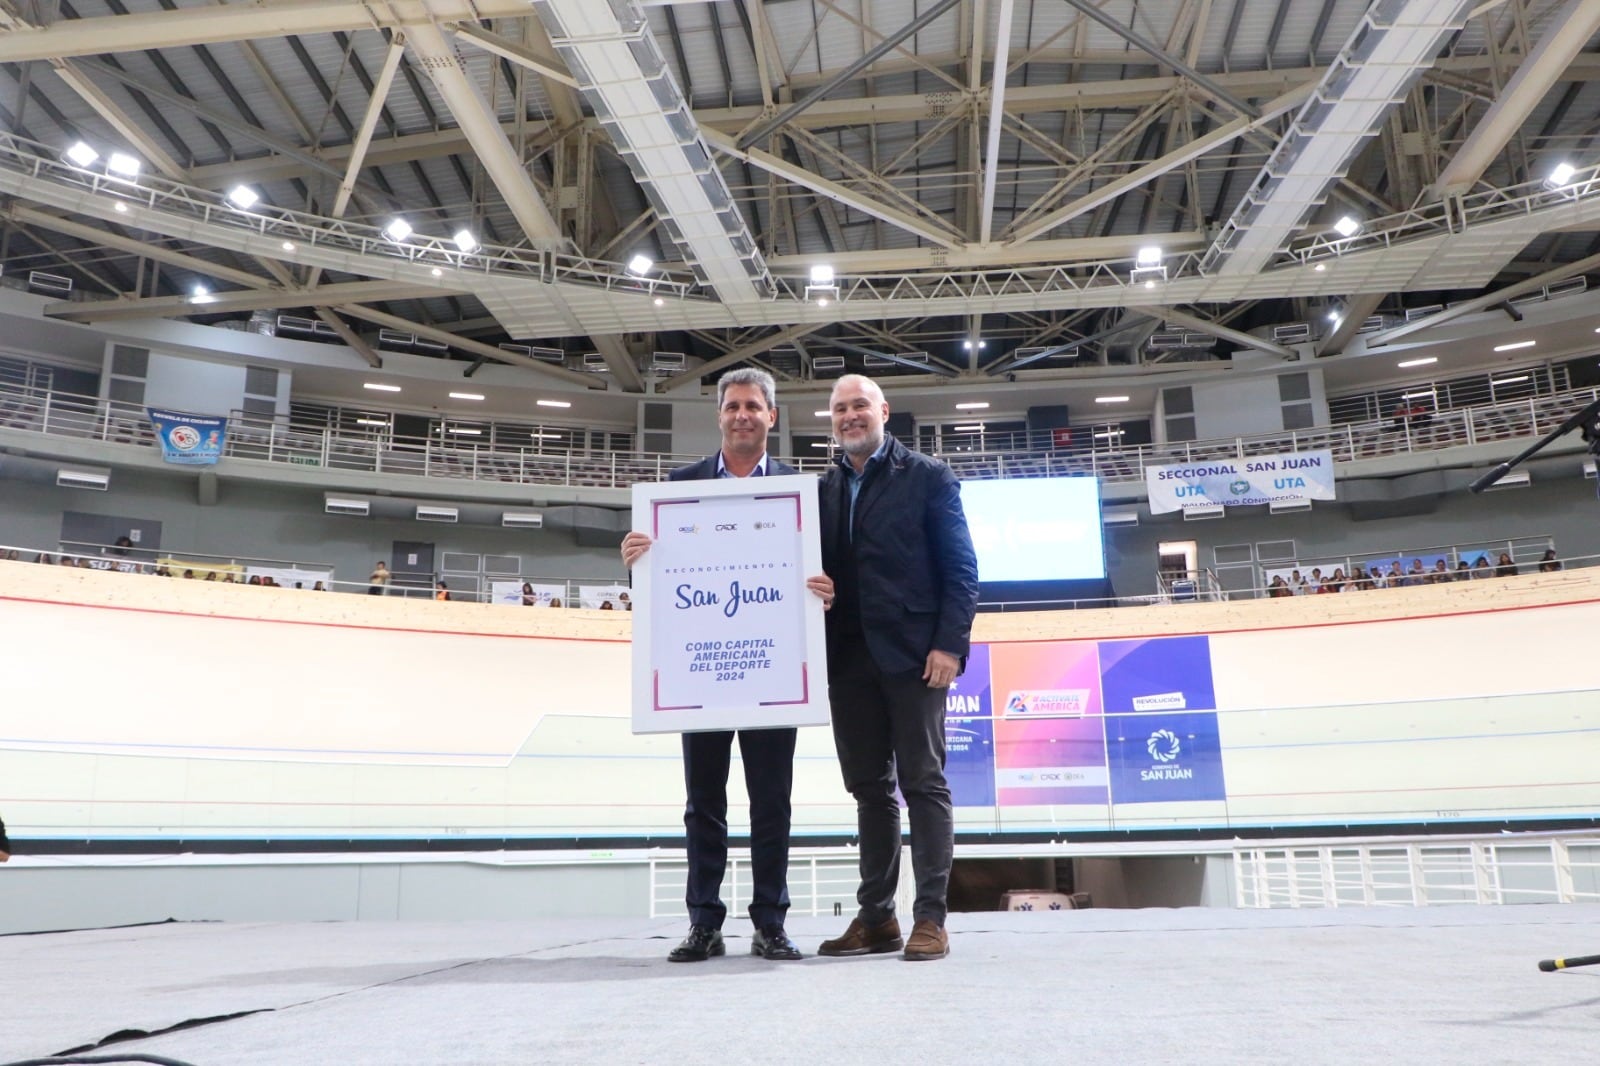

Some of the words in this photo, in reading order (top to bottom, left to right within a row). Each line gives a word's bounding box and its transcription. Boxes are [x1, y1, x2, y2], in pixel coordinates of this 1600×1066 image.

[1158, 465, 1237, 480] SECCIONAL
[1246, 461, 1276, 473] SAN
[1281, 457, 1321, 470] JUAN
[1274, 477, 1306, 490] UTA
[1175, 484, 1206, 498] UTA
[665, 562, 774, 574] RECONOCIMIENTO
[675, 584, 720, 610] San
[723, 580, 783, 618] Juan
[685, 640, 722, 652] COMO
[725, 638, 776, 650] CAPITAL
[693, 649, 766, 661] AMERICANA
[689, 662, 713, 672] DEL
[714, 659, 771, 671] DEPORTE
[715, 671, 745, 682] 2024
[946, 695, 981, 713] UAN
[1032, 702, 1081, 712] AMERICA
[1140, 769, 1164, 782] SAN
[1165, 768, 1193, 780] JUAN
